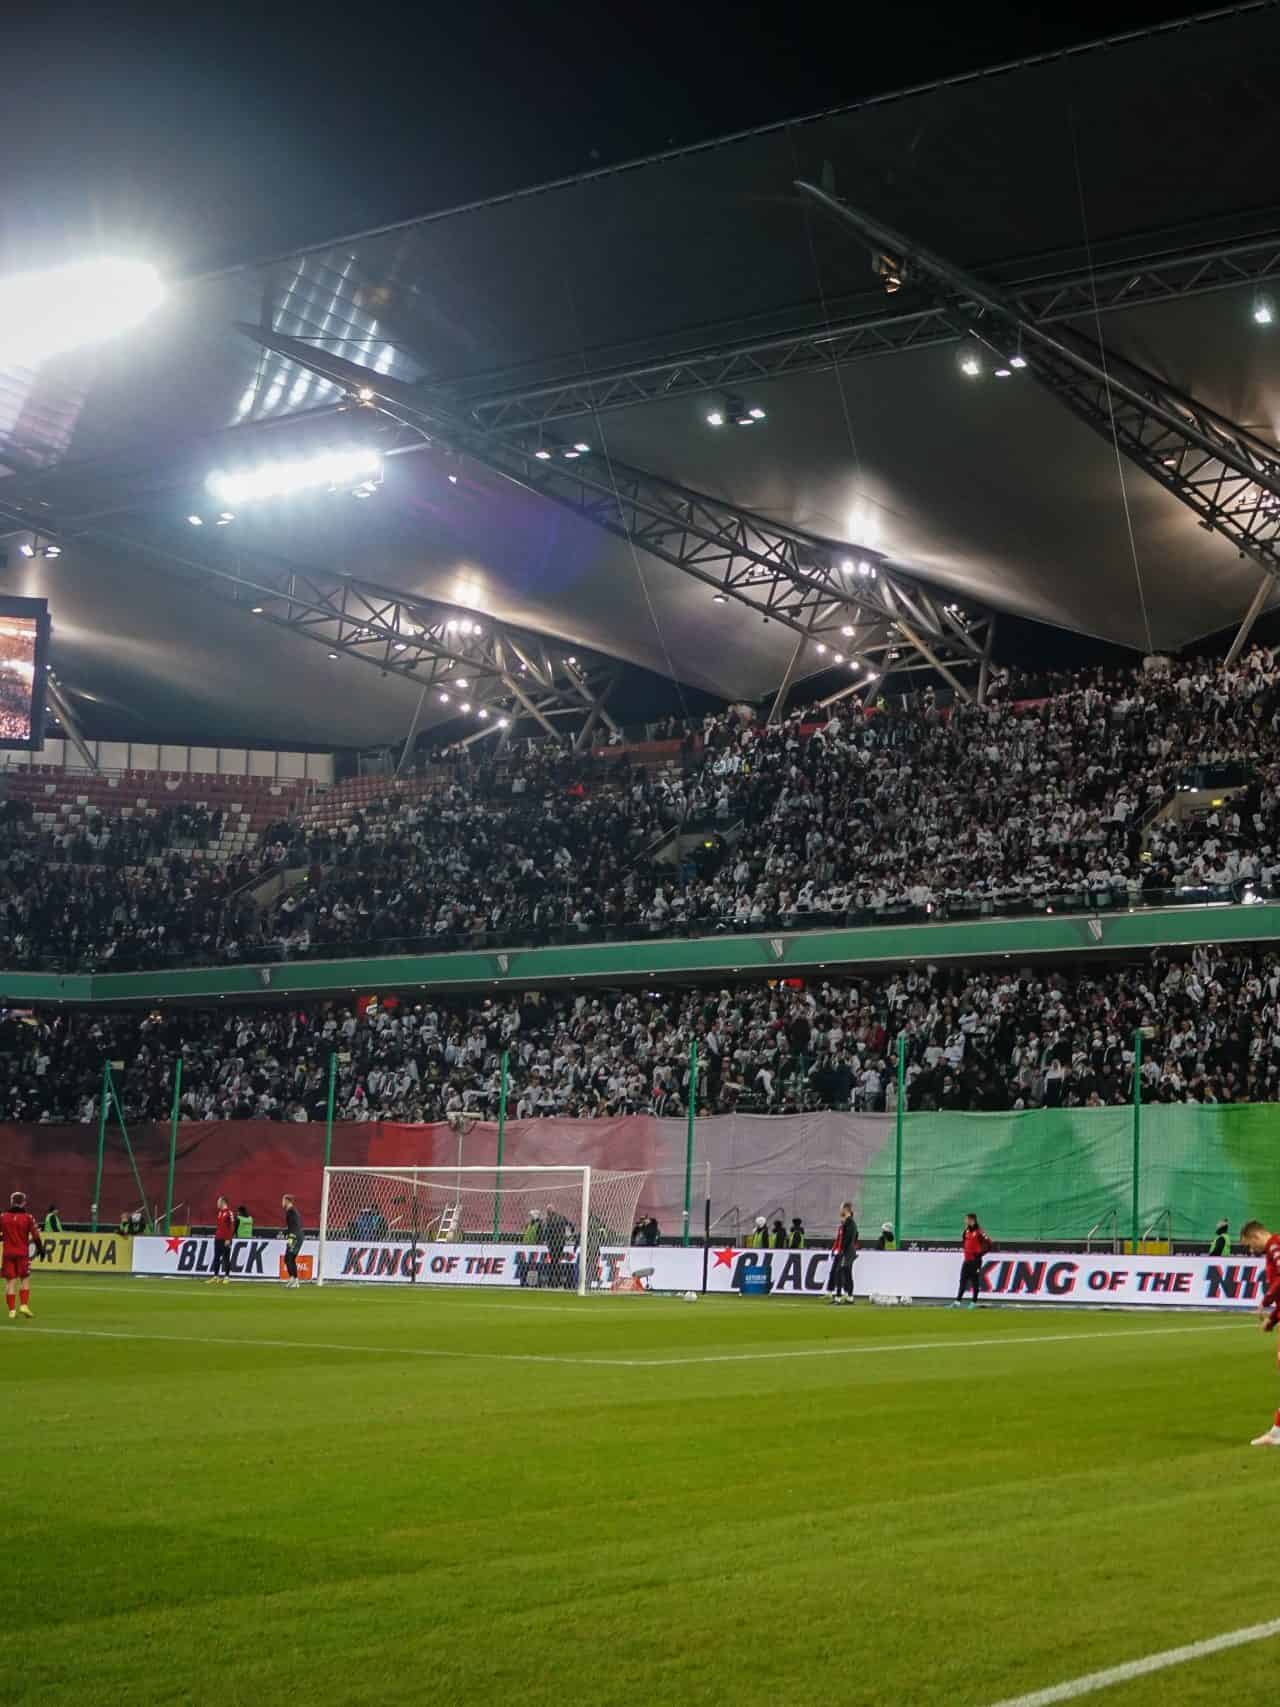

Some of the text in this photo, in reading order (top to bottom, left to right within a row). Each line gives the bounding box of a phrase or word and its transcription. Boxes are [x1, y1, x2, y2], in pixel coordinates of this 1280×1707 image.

[37, 1239, 117, 1264] RTUNA
[342, 1247, 426, 1276] KING
[431, 1257, 459, 1273] OF
[464, 1258, 504, 1275] THE
[731, 1252, 834, 1292] BLAC
[1087, 1271, 1129, 1292] OF
[1135, 1271, 1194, 1293] THE
